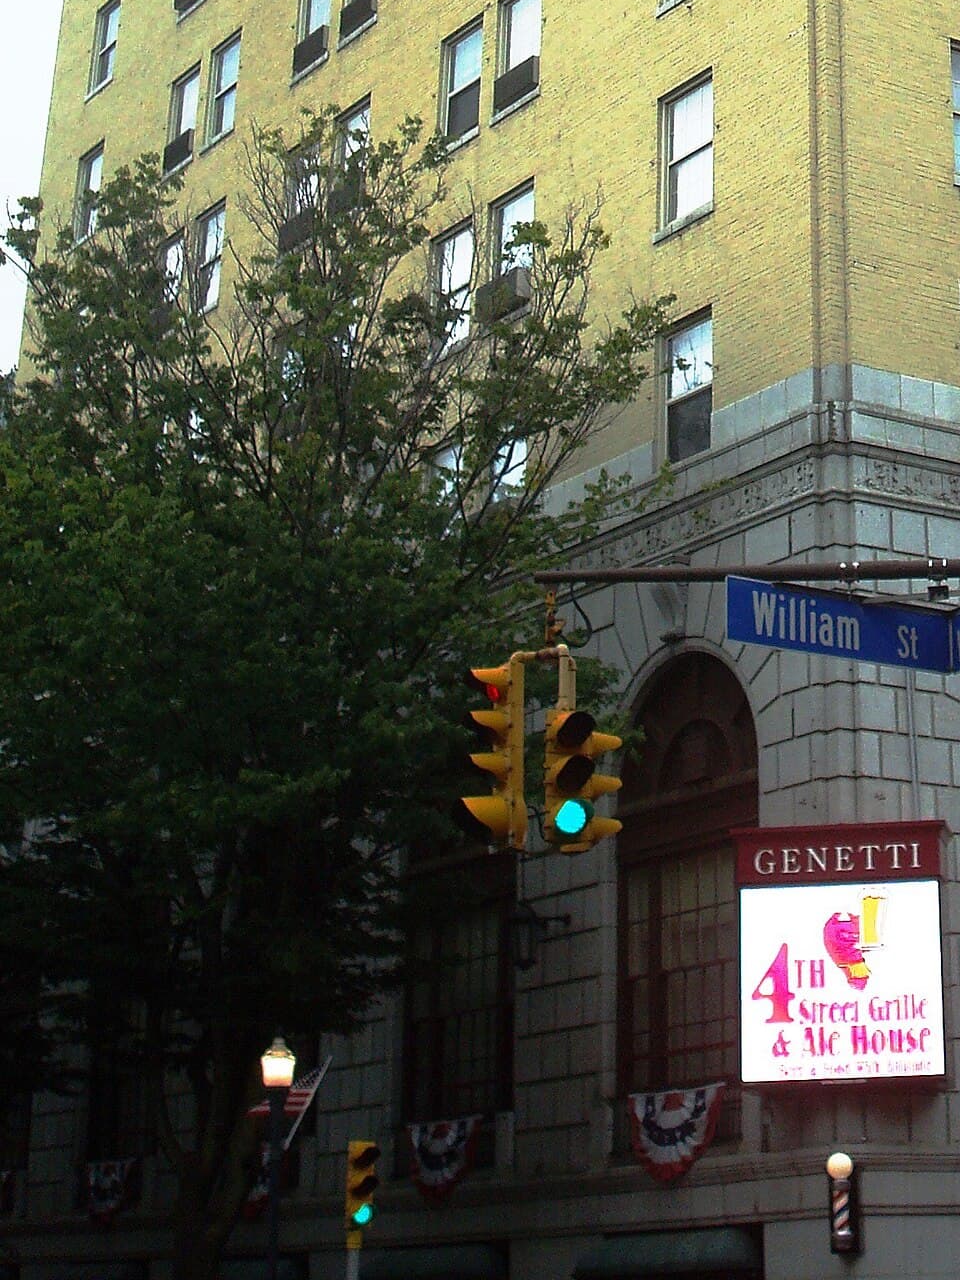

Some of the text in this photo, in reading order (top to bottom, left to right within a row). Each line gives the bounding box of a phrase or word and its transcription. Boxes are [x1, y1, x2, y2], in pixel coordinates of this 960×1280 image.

[752, 590, 919, 660] William St
[754, 843, 921, 875] GENETTI
[799, 994, 928, 1025] Street Grille
[772, 1024, 931, 1057] & Ale House
